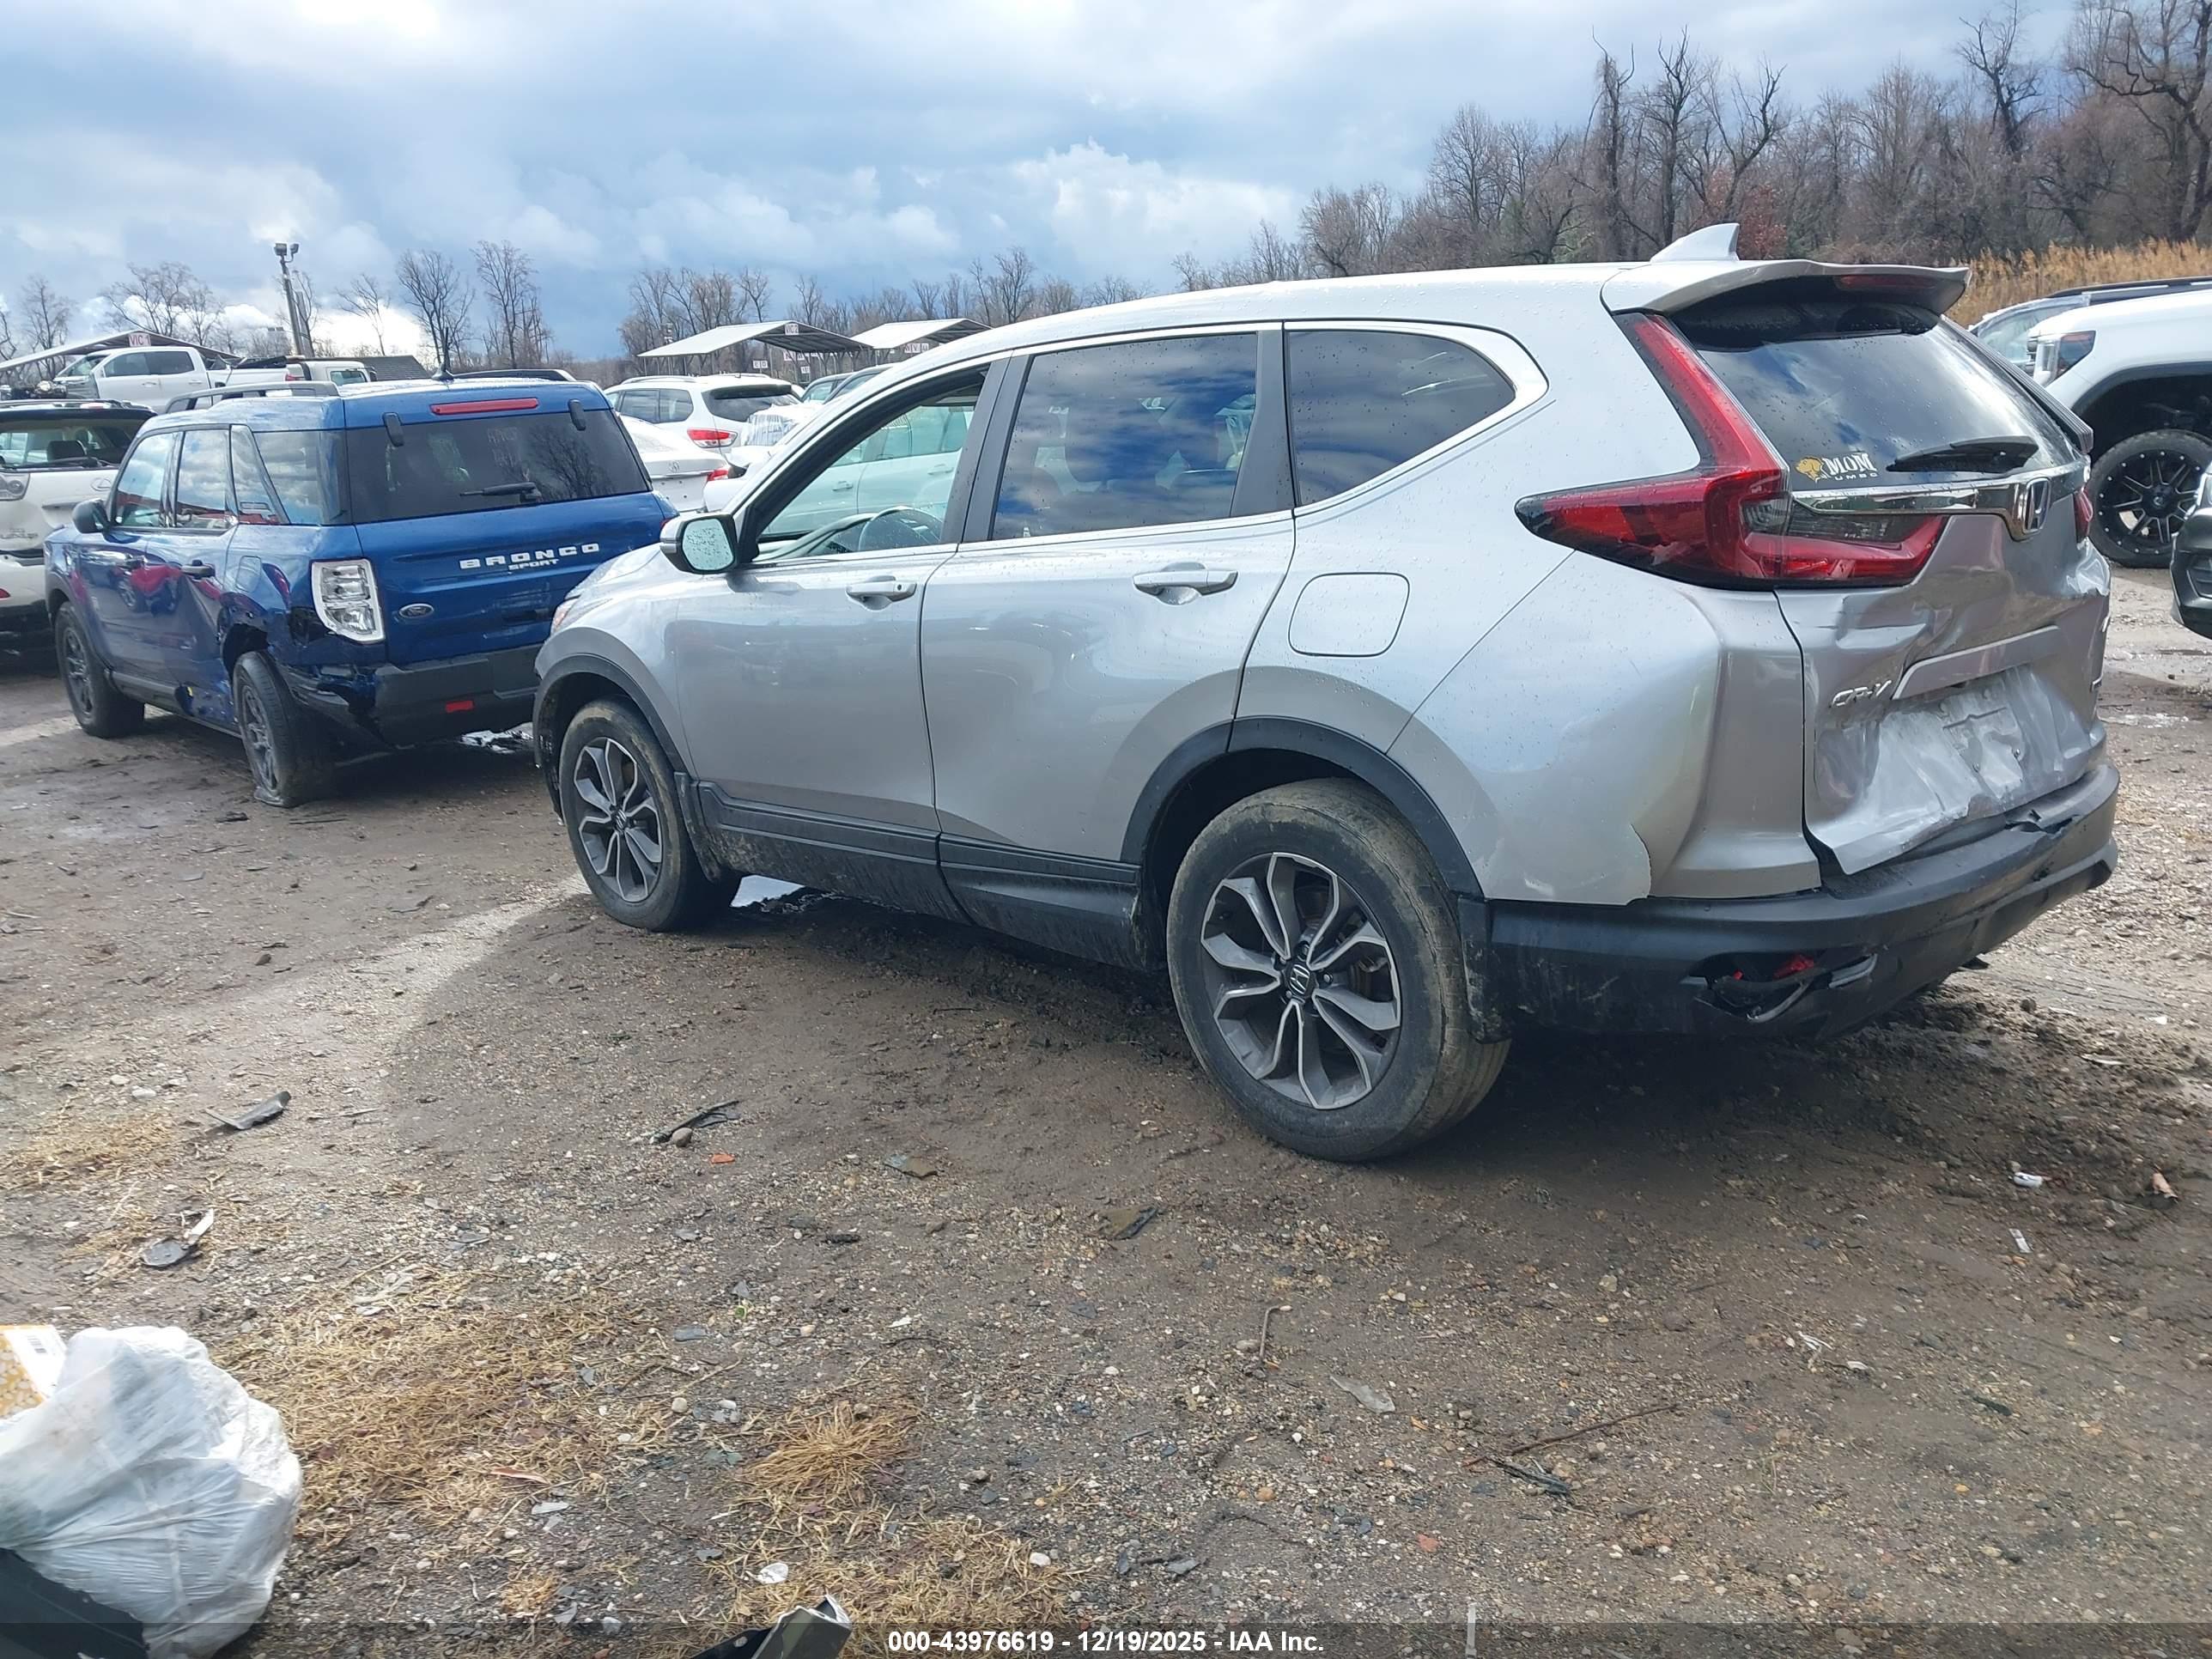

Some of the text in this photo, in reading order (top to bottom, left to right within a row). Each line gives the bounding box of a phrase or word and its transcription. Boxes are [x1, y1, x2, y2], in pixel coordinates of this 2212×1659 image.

[130, 335, 143, 345] VIC
[1821, 453, 1878, 476] MOM
[459, 543, 600, 569] BRONCO
[508, 558, 560, 571] SPORT
[1832, 679, 1893, 707] CR-V
